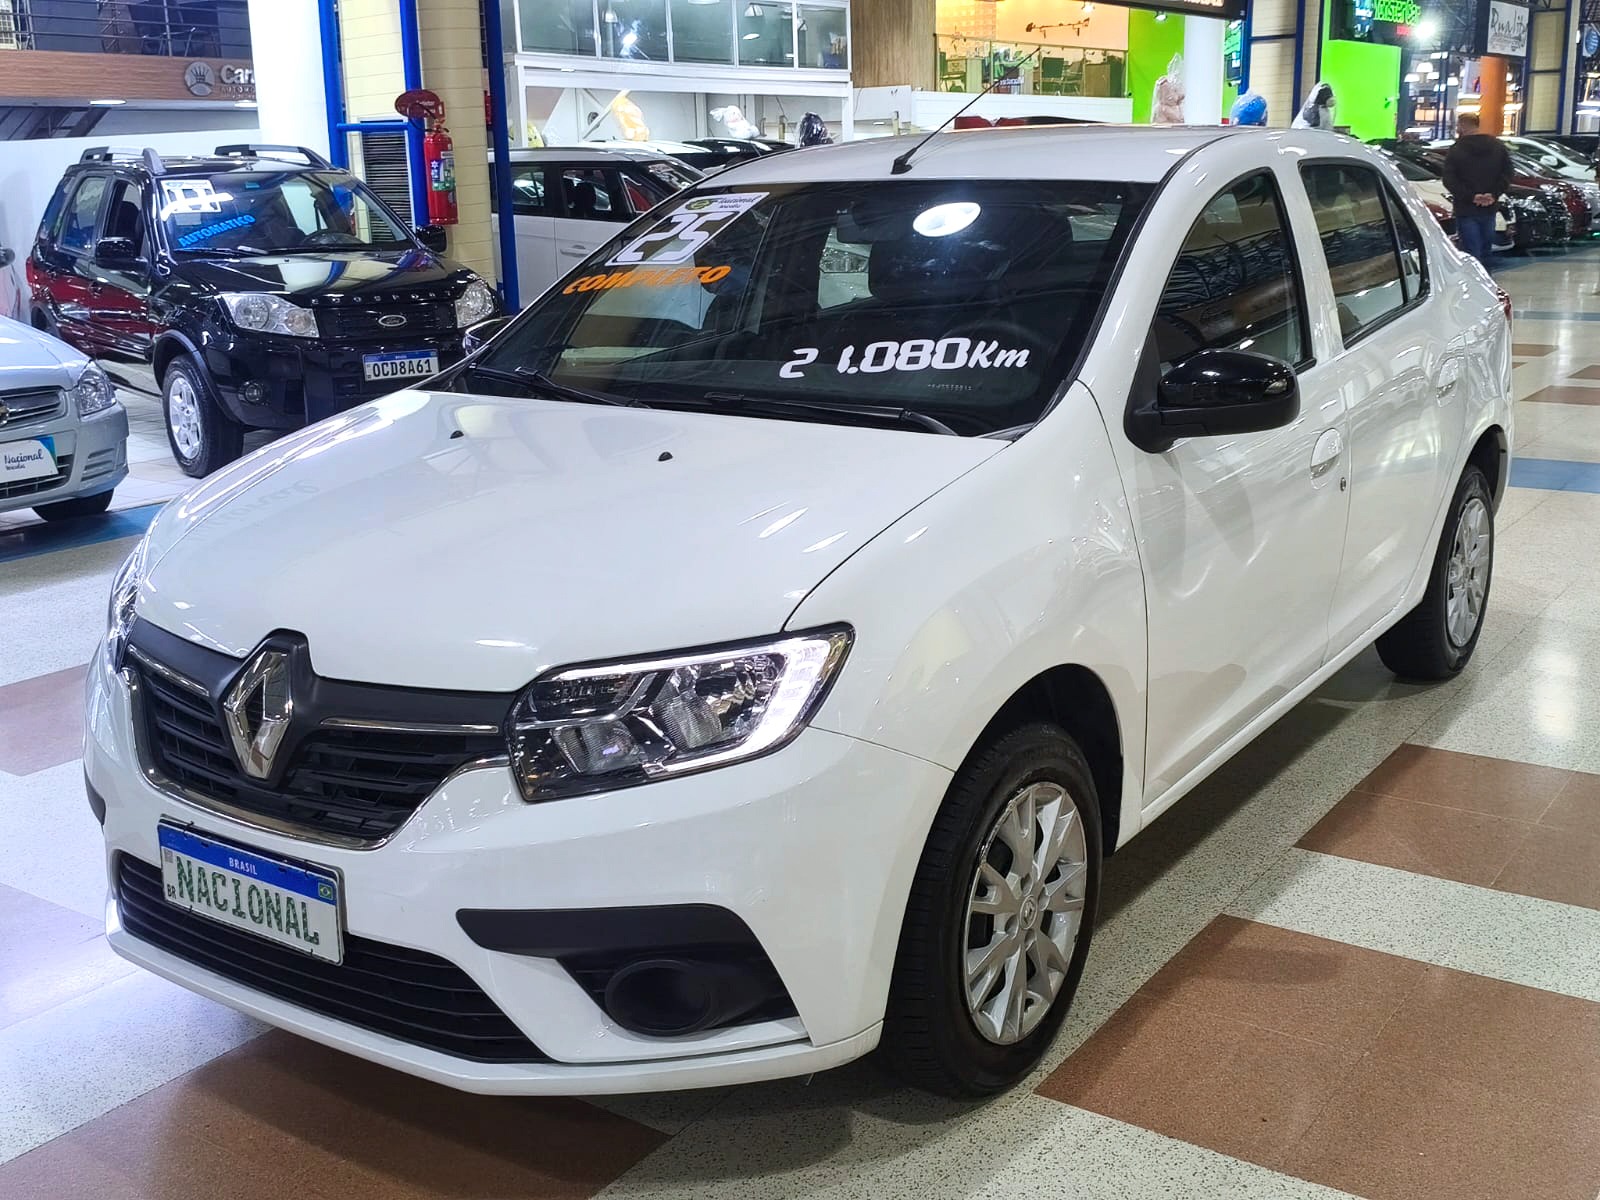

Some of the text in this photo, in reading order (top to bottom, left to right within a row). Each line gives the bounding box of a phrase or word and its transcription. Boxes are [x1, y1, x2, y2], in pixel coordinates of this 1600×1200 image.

[616, 211, 735, 262] 25
[562, 265, 732, 295] COMPLETO
[372, 359, 432, 378] OCD8A61
[4, 448, 44, 464] Nacional
[228, 857, 258, 876] BRASIL
[167, 883, 177, 899] BR
[176, 855, 320, 946] NACIONAL
